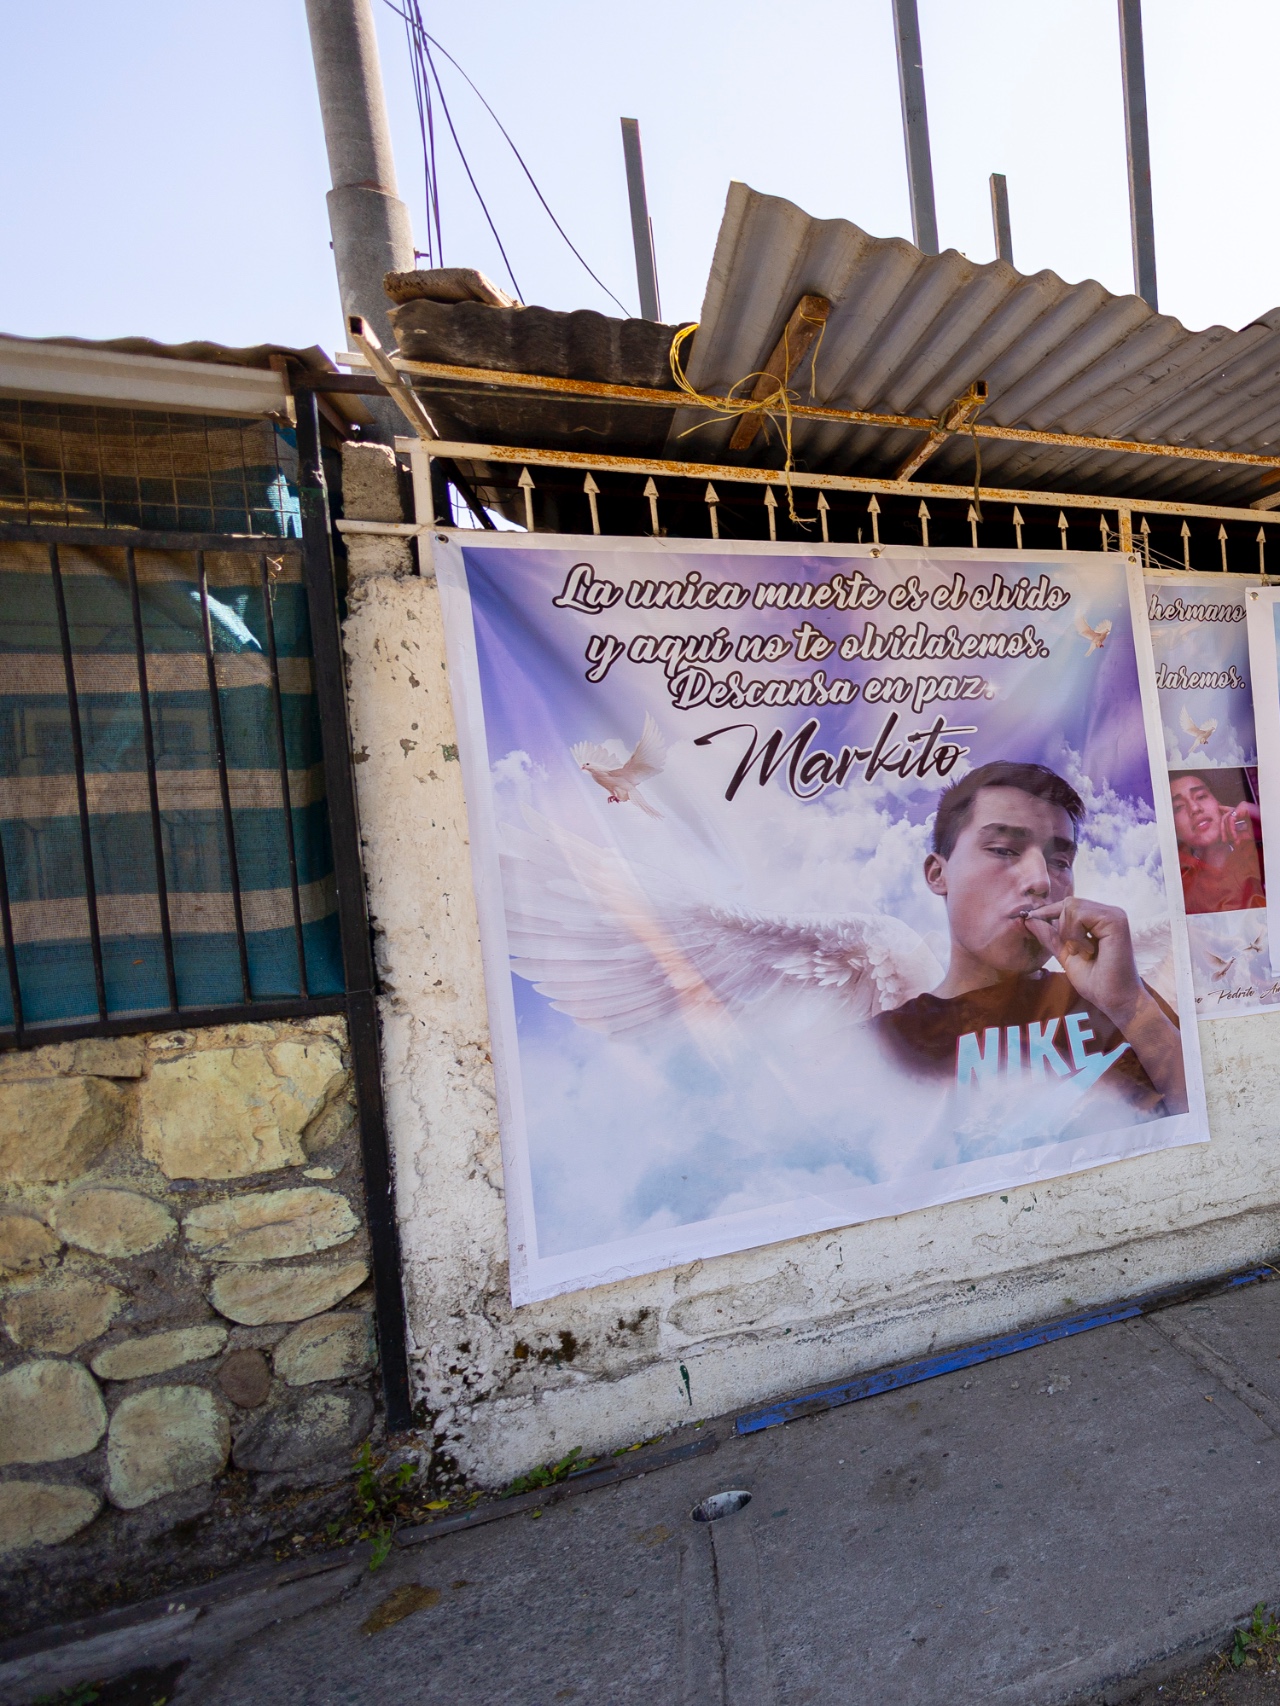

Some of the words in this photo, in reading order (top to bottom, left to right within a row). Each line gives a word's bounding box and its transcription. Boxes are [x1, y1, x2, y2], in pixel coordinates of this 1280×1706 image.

[552, 563, 623, 615] La
[626, 571, 751, 610] unica
[752, 570, 886, 611] muerte
[888, 575, 928, 611] es
[931, 572, 968, 611] el
[970, 573, 1071, 611] olvido
[585, 635, 625, 683] y
[627, 626, 734, 679] aquí
[735, 634, 792, 662] no
[793, 621, 836, 661] te
[838, 621, 1050, 661] olvidaremos.
[667, 664, 860, 710] Descansa
[863, 676, 913, 703] en
[911, 675, 995, 714] paz.
[693, 711, 978, 802] Markito
[956, 1012, 1103, 1096] NIKE
